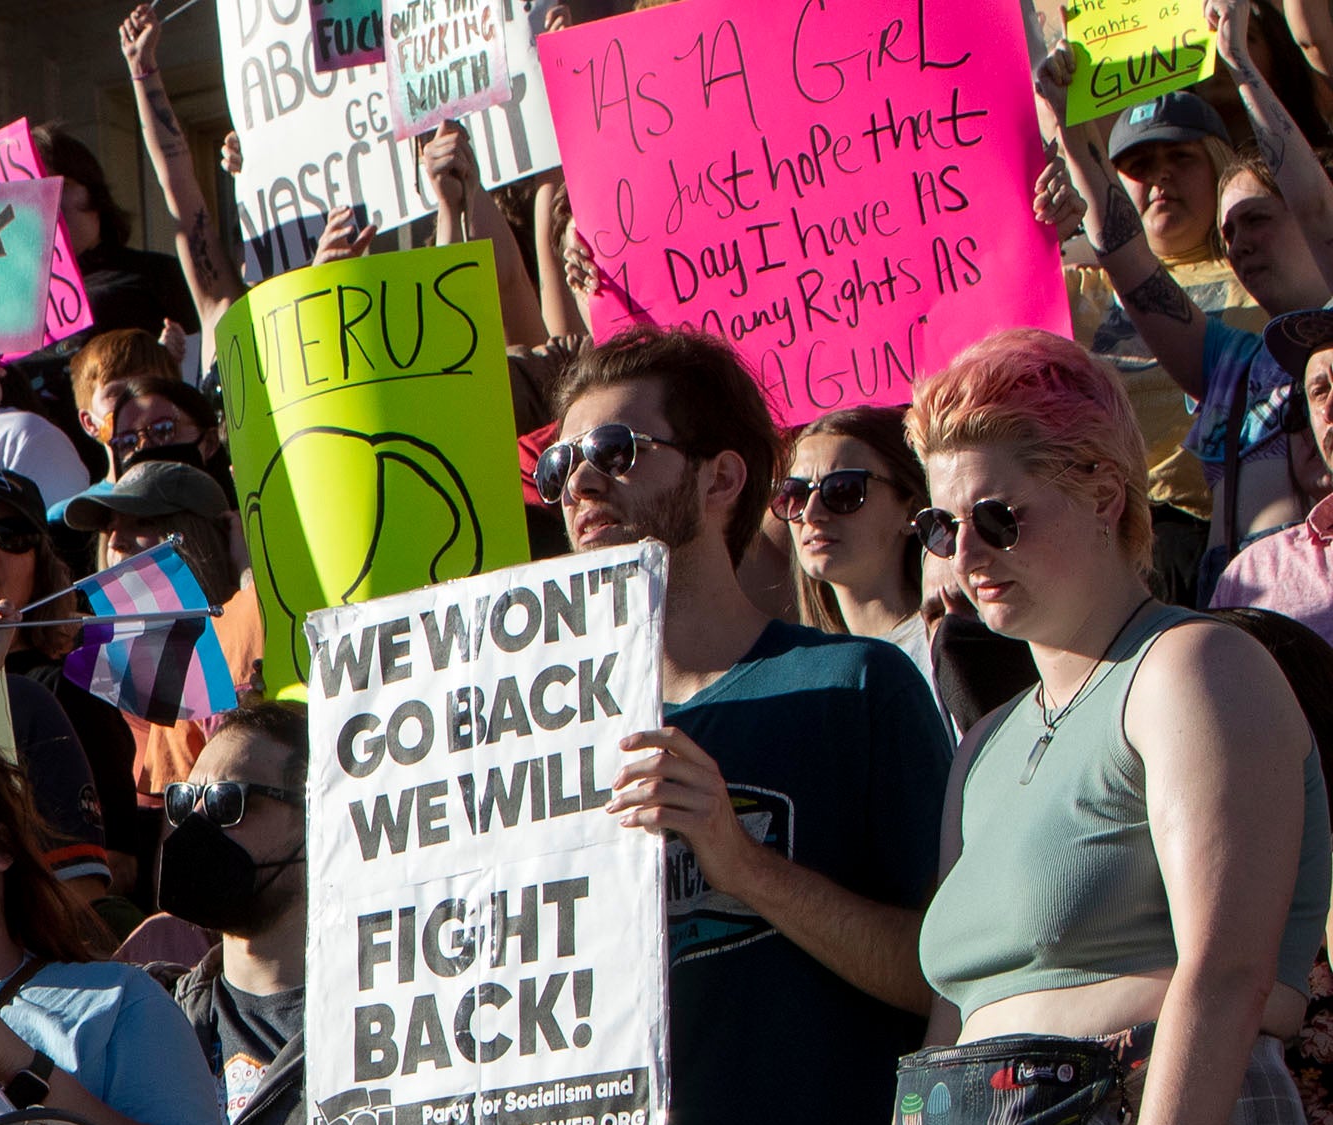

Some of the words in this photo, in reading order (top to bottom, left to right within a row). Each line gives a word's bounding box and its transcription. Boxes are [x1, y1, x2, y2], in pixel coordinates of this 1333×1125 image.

[407, 50, 490, 117] MOUTH
[674, 20, 761, 131] A
[1083, 14, 1140, 49] rights
[1090, 29, 1207, 98] GUNS
[863, 87, 988, 163] that
[665, 239, 750, 304] Day
[746, 221, 786, 273] I
[791, 199, 902, 259] have
[796, 257, 924, 332] Rights
[251, 262, 479, 394] UTERUS
[316, 616, 413, 700] WE
[420, 559, 639, 672] WON'T
[336, 699, 435, 779] GO
[446, 652, 623, 754] BACK
[348, 779, 451, 862] WE
[457, 746, 614, 836] WILL
[357, 876, 590, 992] FIGHT
[354, 968, 594, 1083] BACK!
[422, 1102, 469, 1125] Party
[505, 1080, 592, 1112] Socialism
[595, 1074, 634, 1099] and
